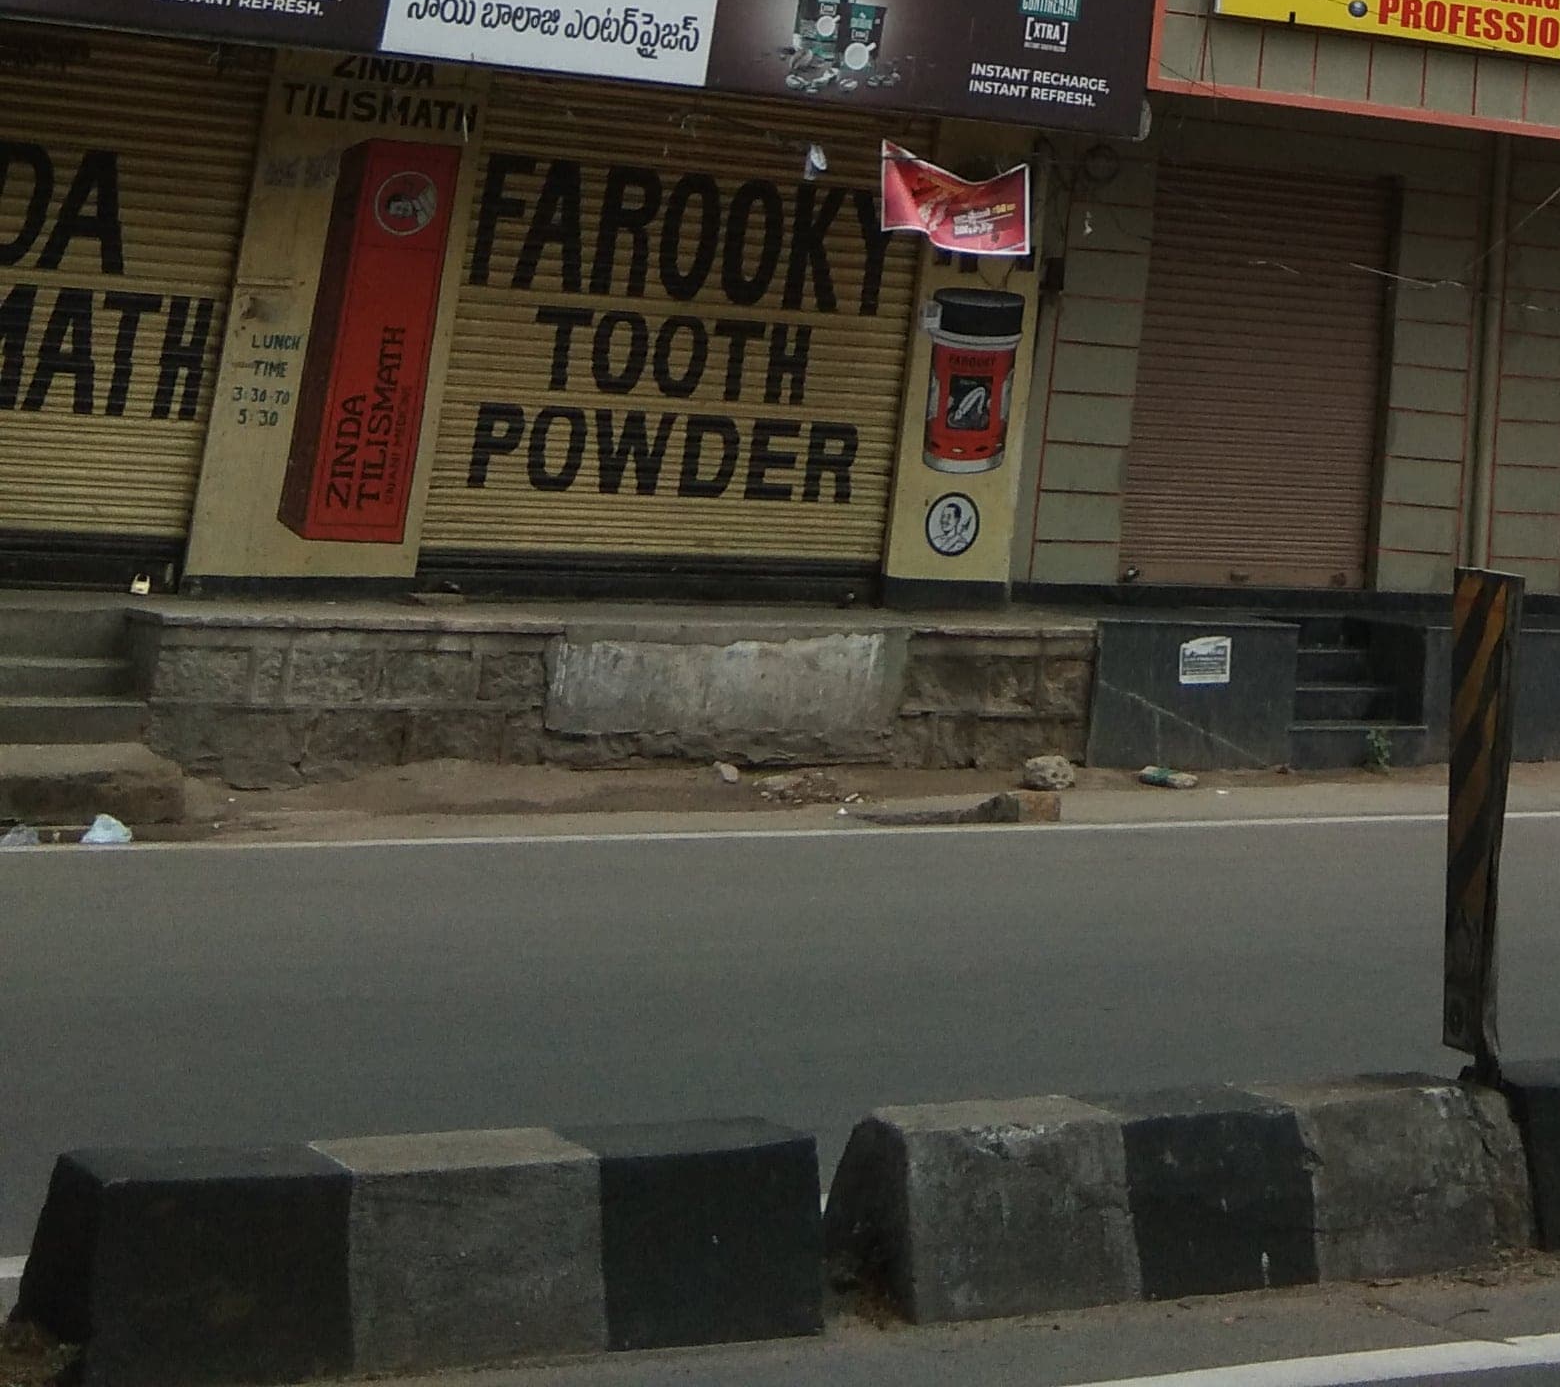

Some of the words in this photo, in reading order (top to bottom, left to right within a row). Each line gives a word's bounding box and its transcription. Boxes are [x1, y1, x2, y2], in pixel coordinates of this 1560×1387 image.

[481, 2, 560, 36] బాలాజి
[334, 55, 434, 86] ZINDA
[971, 62, 1031, 87] INSTANT
[1033, 70, 1110, 94] RECHARGE,
[283, 82, 479, 133] TILISMATH
[969, 79, 1027, 100] INSTANT
[1031, 88, 1096, 108] REFRESH.
[470, 153, 895, 316] FAROOKY
[252, 334, 302, 351] LUNCH
[535, 305, 813, 406] TOOTH
[254, 360, 288, 378] TIME
[356, 326, 405, 511] TILISMATH
[326, 394, 367, 509] ZINDA
[466, 402, 859, 505] POWDER
